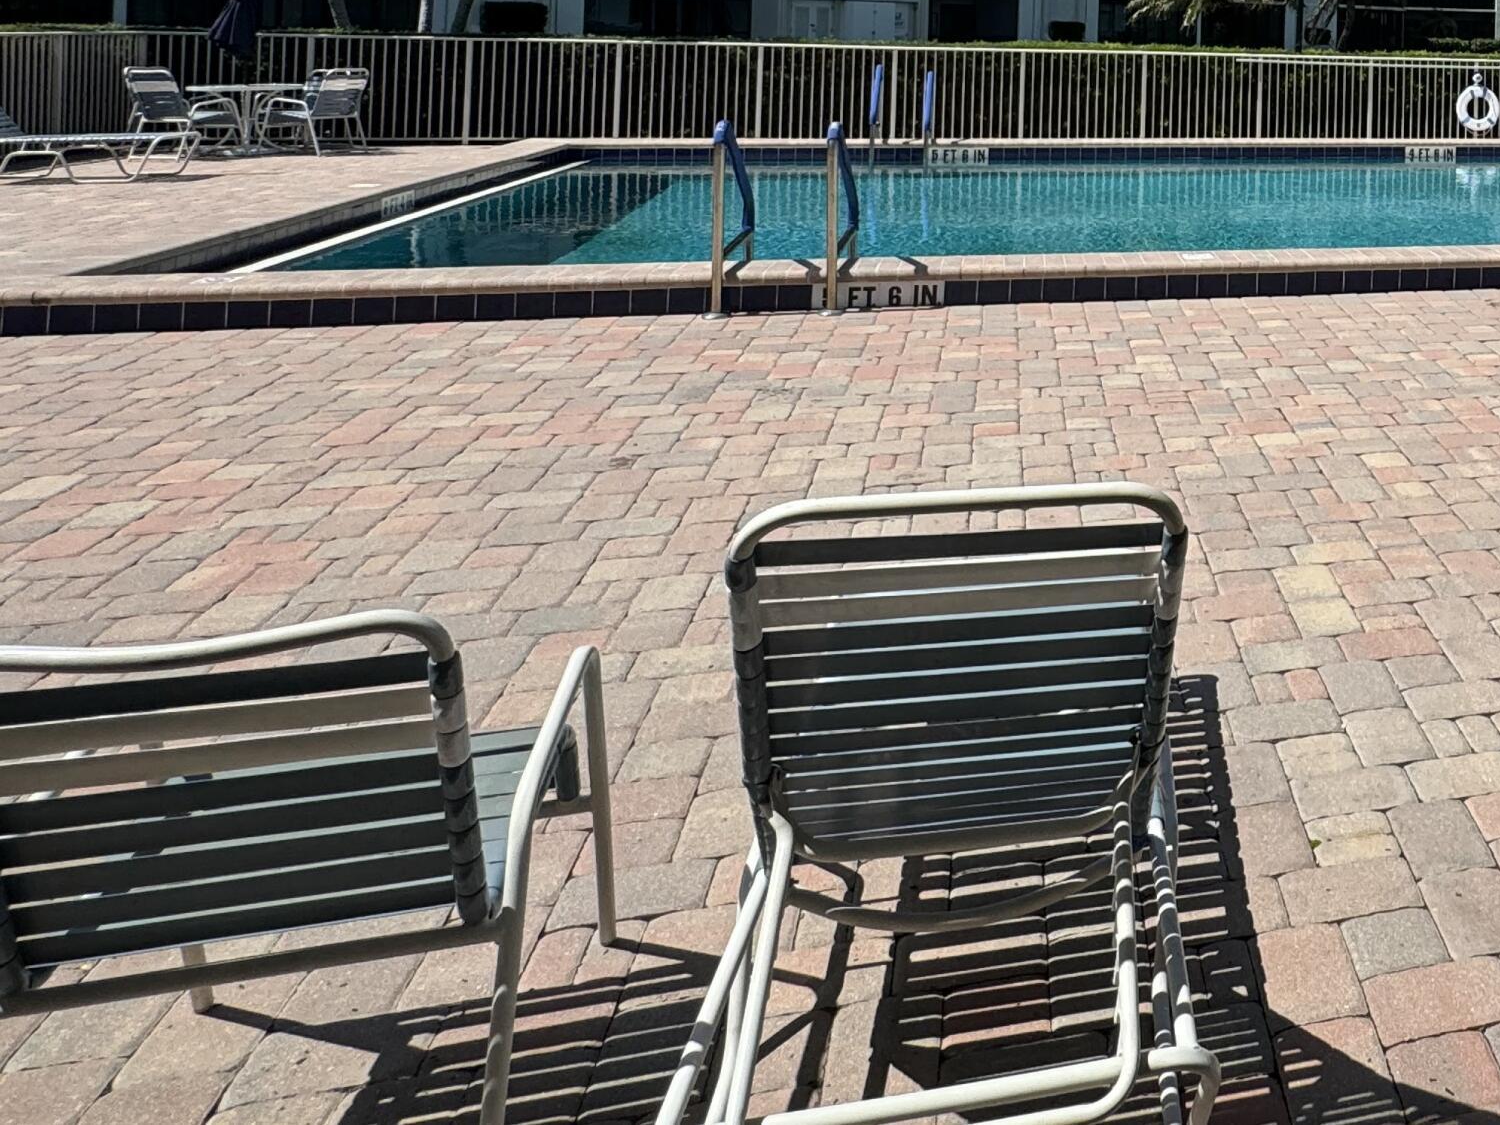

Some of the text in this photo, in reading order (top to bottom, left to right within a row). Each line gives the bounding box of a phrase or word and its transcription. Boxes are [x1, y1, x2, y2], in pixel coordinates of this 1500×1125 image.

[974, 149, 985, 164] IN
[1443, 148, 1454, 162] IN
[888, 286, 901, 306] 6
